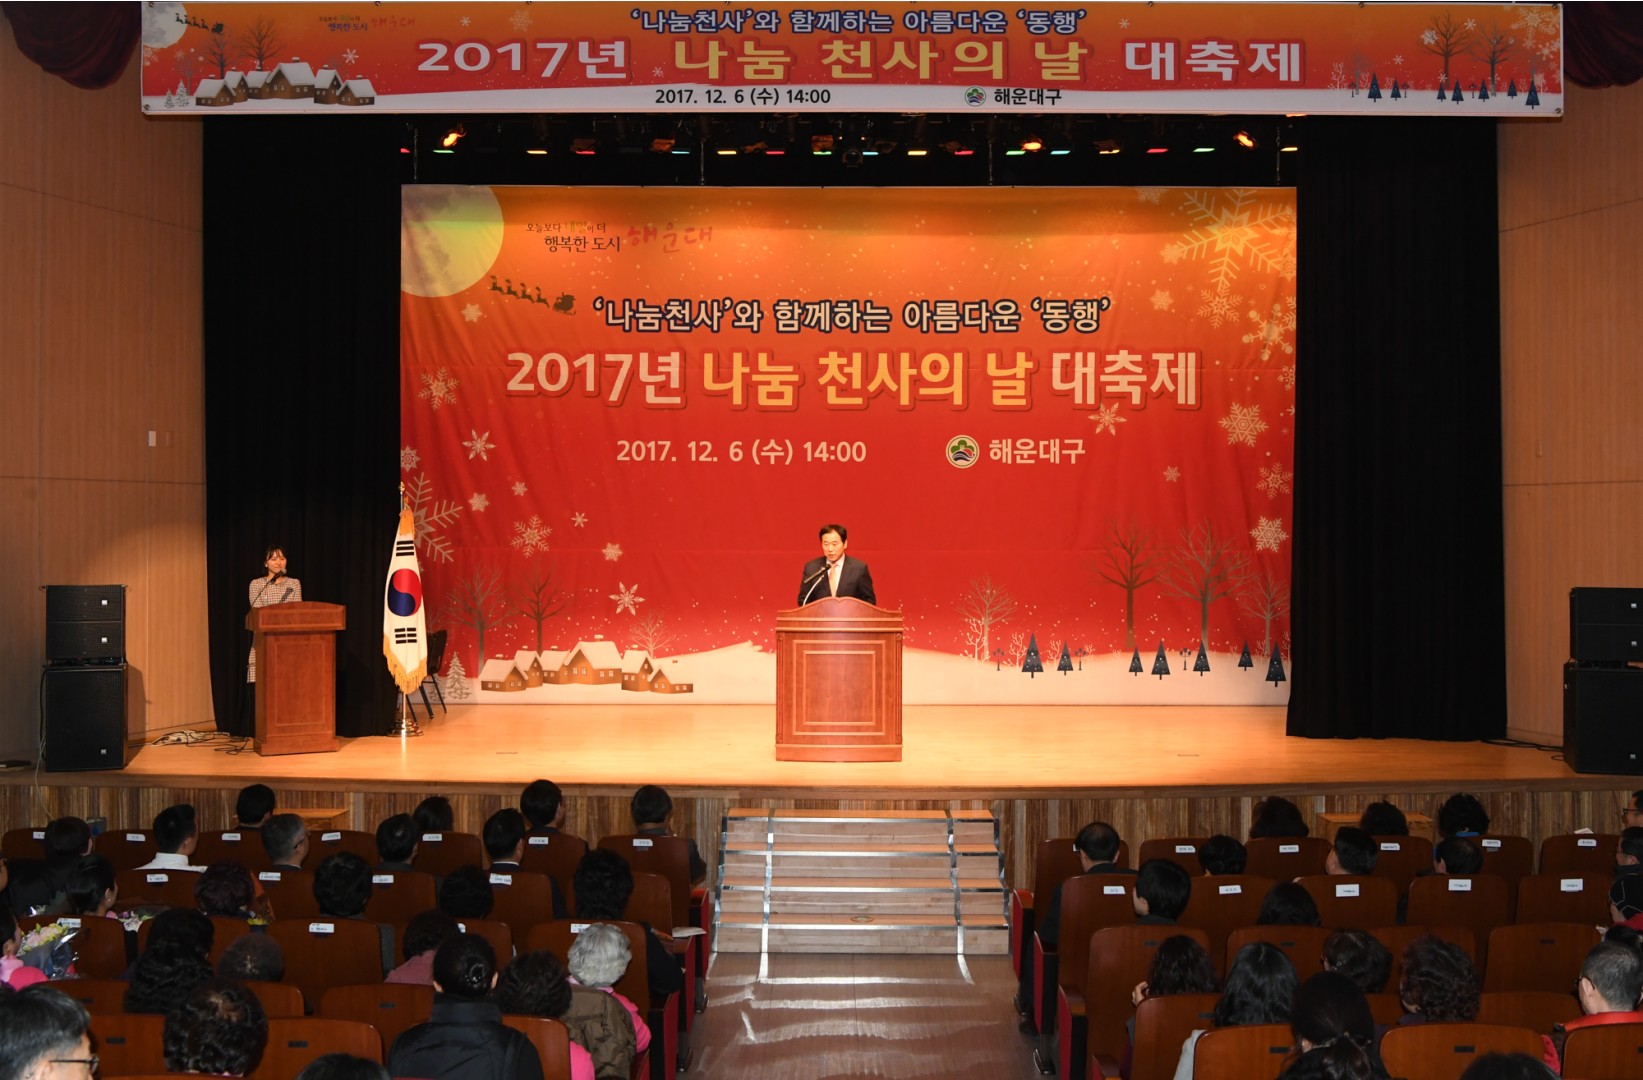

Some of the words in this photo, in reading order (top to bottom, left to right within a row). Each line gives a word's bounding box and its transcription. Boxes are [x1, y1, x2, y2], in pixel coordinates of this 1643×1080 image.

[790, 10, 893, 33] 함께하는
[904, 10, 1007, 34] 아름다운
[417, 40, 627, 79] 2017년
[674, 40, 791, 80] 나눔
[819, 40, 1004, 80] 천사의
[1034, 40, 1088, 81] 날
[1125, 41, 1300, 82] 대축제
[655, 88, 698, 104] 2017.
[705, 88, 727, 104] 12.
[734, 88, 744, 104] 6
[750, 88, 780, 105] (수)
[786, 88, 831, 104] 14:00
[993, 88, 1062, 106] 해운대구
[525, 222, 562, 234] 오늘보다
[627, 222, 713, 253] 해운대
[544, 235, 589, 253] 행복한
[591, 236, 621, 252] 도시
[774, 298, 892, 333] 함께하는
[903, 299, 1022, 334] 아름다운
[506, 351, 682, 405] 2017년
[703, 352, 800, 406] 나눔
[817, 351, 964, 406] 천사의
[986, 352, 1034, 406] 날
[1051, 350, 1197, 406] 대축제
[616, 440, 678, 462] 2017.
[687, 440, 718, 462] 12.
[728, 440, 744, 462] 6
[751, 439, 794, 465] (수)
[803, 441, 867, 462] 14:00
[988, 438, 1086, 464] 해운대구
